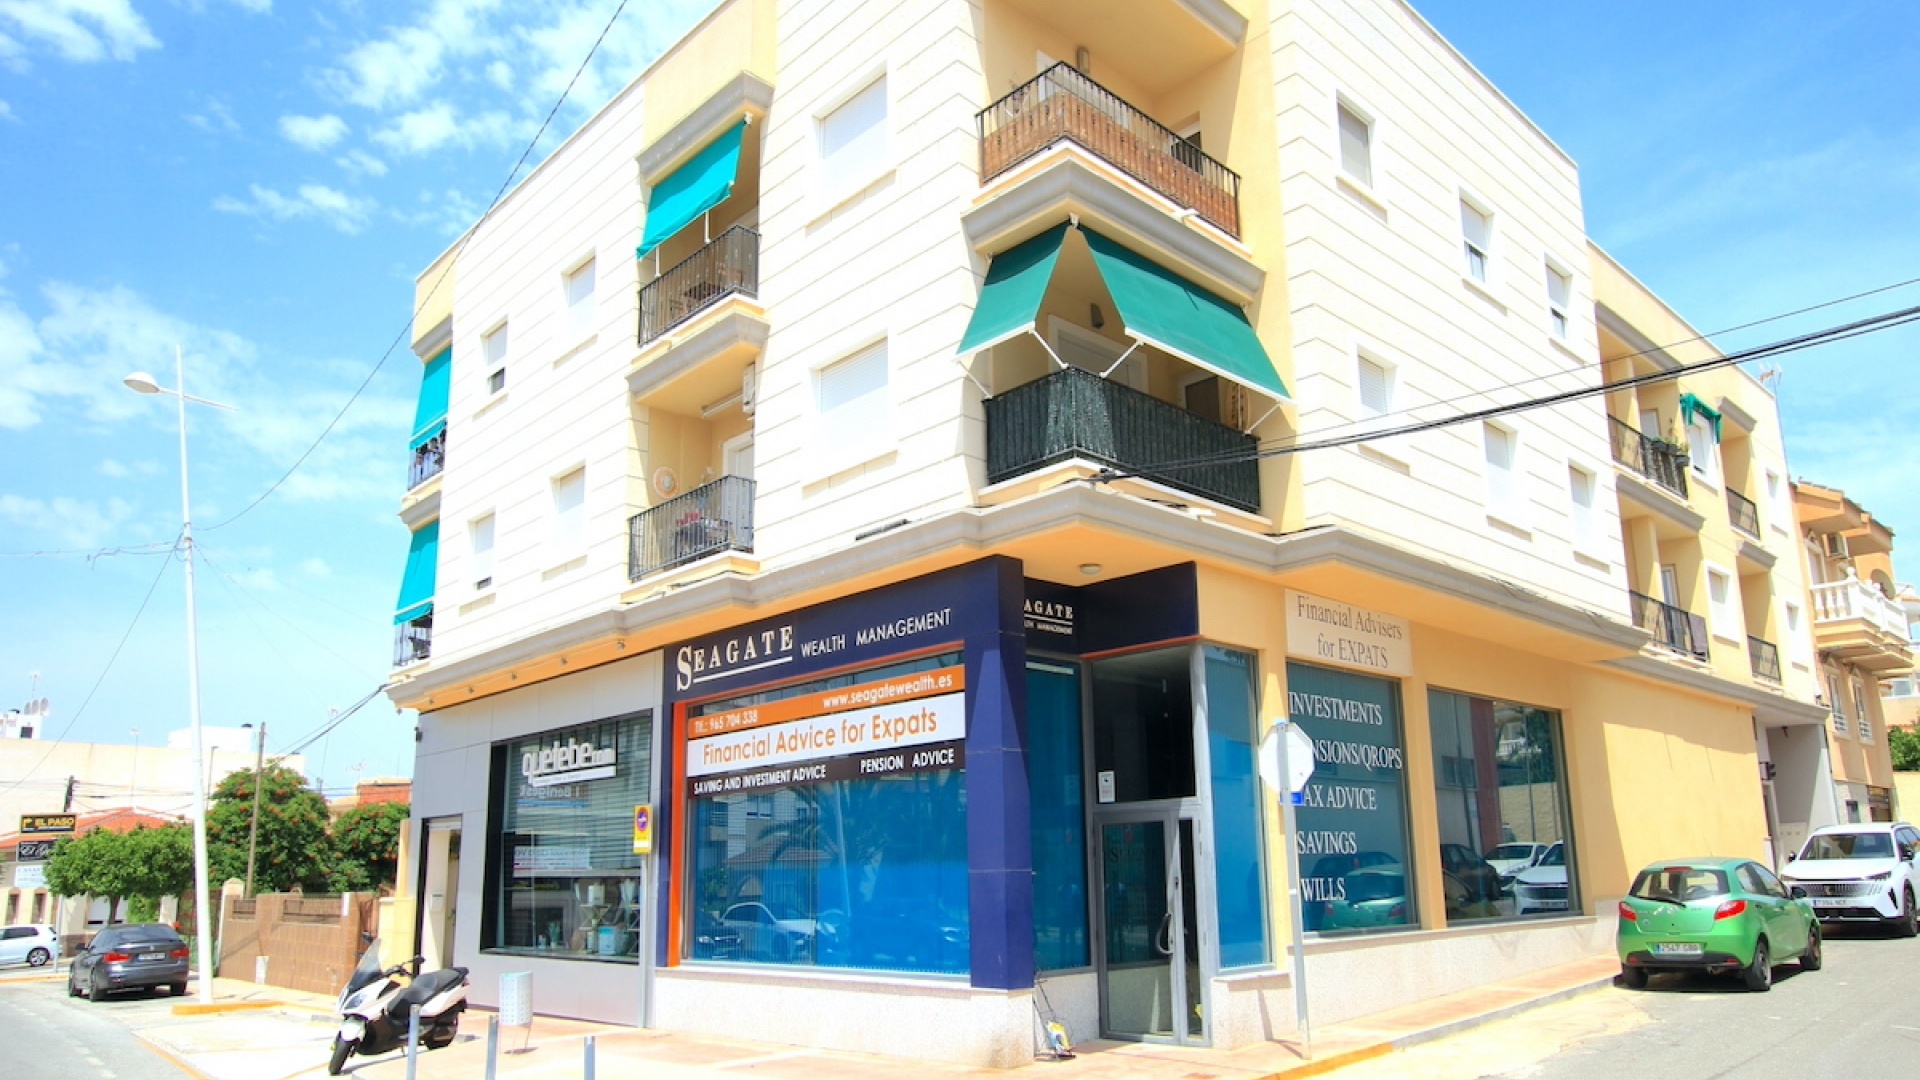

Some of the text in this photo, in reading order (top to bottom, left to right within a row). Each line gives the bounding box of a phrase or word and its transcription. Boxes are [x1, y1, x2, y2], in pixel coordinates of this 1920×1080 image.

[1023, 599, 1072, 619] AGATE
[1297, 595, 1402, 640] Financial Advisers
[800, 609, 951, 657] WEALTH MANAGEMENT
[676, 625, 793, 691] SEAGATE
[1317, 632, 1388, 668] for EXPATS
[823, 674, 953, 709] www.seagatewealth.es
[709, 715, 724, 730] 965
[726, 712, 740, 727] 704
[742, 709, 758, 724] 338
[1289, 691, 1383, 726] INVESTMENTS
[703, 706, 937, 765] Financial Advice for Expats
[860, 748, 955, 774] PENSION ADVICE
[1312, 739, 1402, 771] NSIONS/QROPS
[694, 764, 827, 794] SAVING AND INVESTMENT ADVICE
[1303, 785, 1377, 810] AX ADVICE
[47, 817, 74, 827] PASO
[1297, 831, 1358, 854] SAVINGS
[1300, 878, 1346, 902] WILLS
